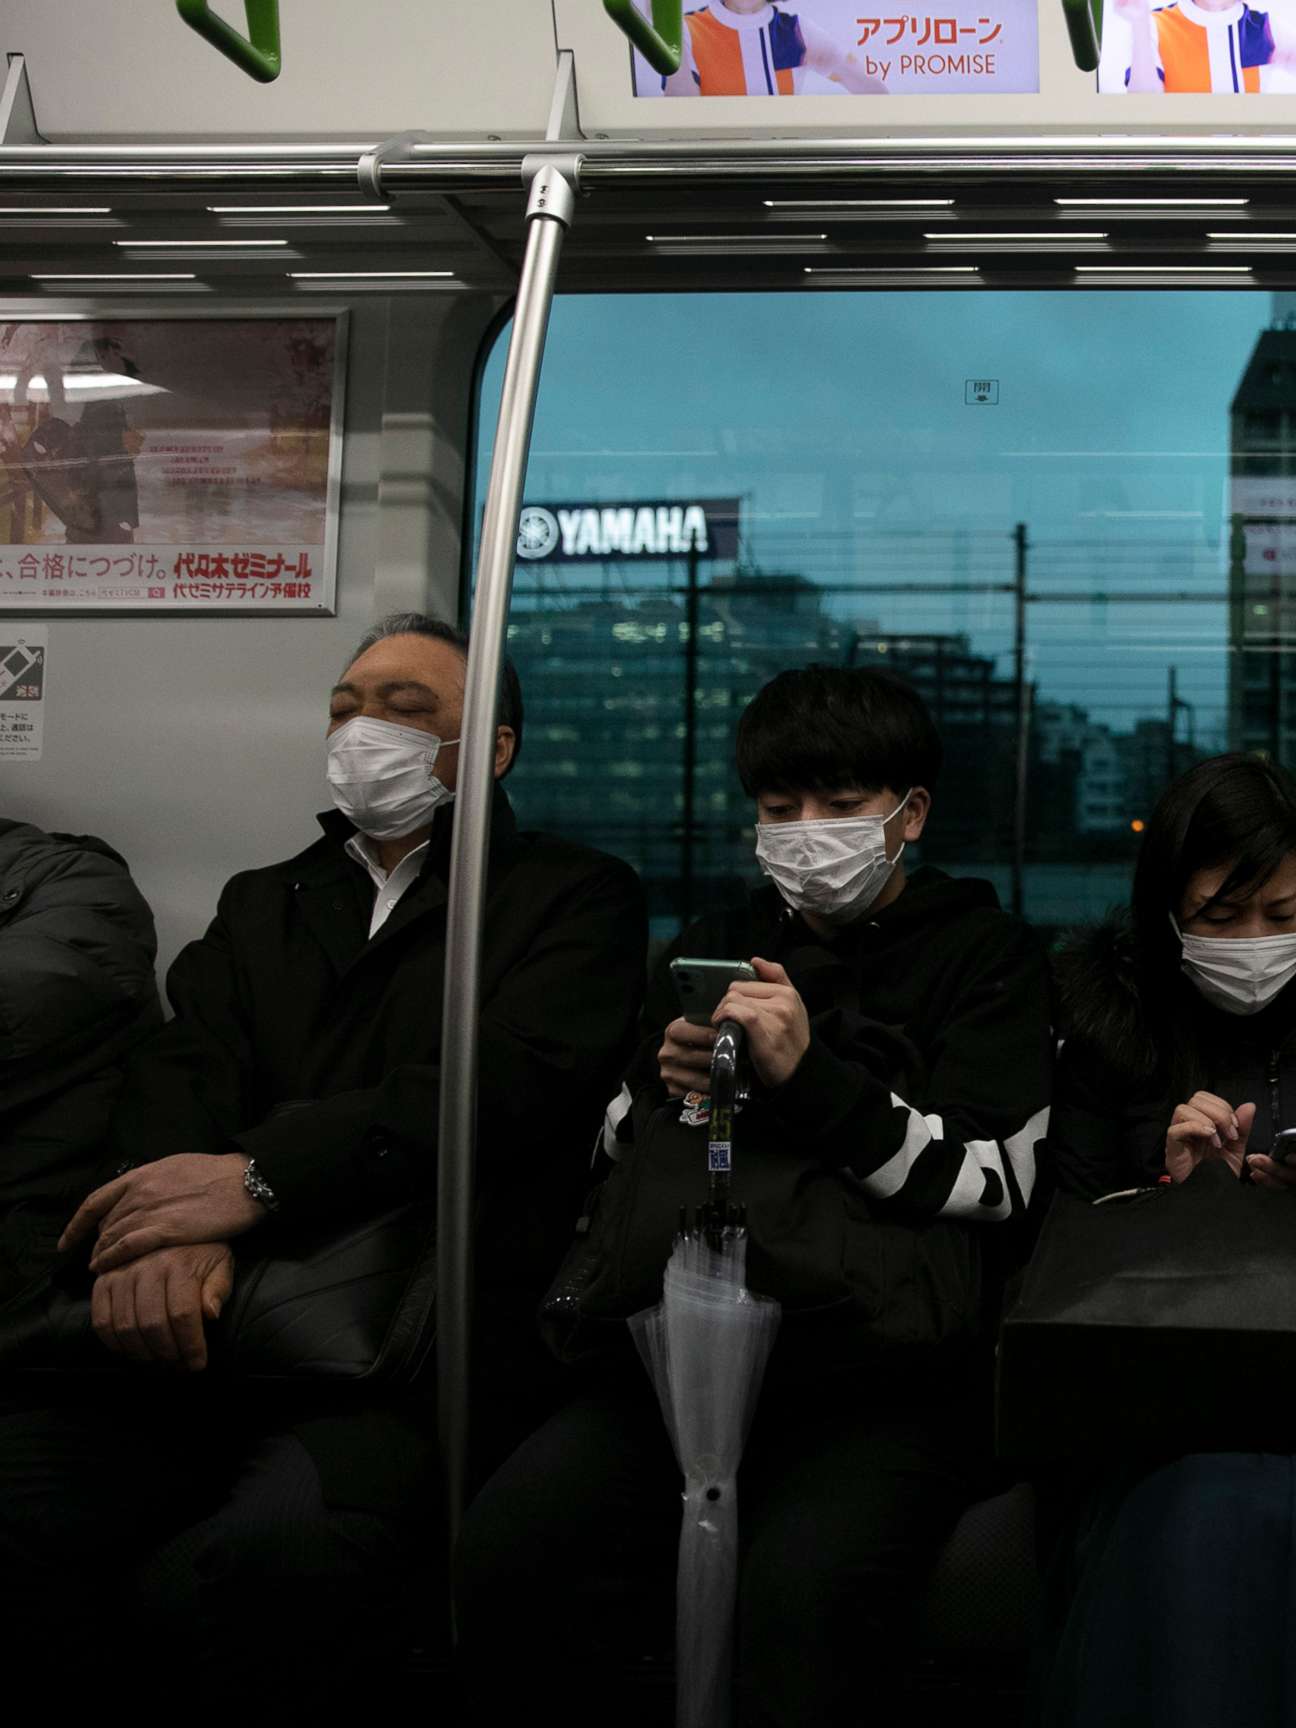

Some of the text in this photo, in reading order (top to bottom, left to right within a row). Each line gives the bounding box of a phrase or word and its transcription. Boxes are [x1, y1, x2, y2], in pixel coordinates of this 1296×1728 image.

[856, 15, 1002, 46] アプリローン
[866, 54, 996, 81] by PROMISE
[557, 506, 708, 556] YAMAHA
[173, 552, 312, 579] 代々木ゼミナール
[173, 583, 311, 599] 代ゼミサテライン予備校
